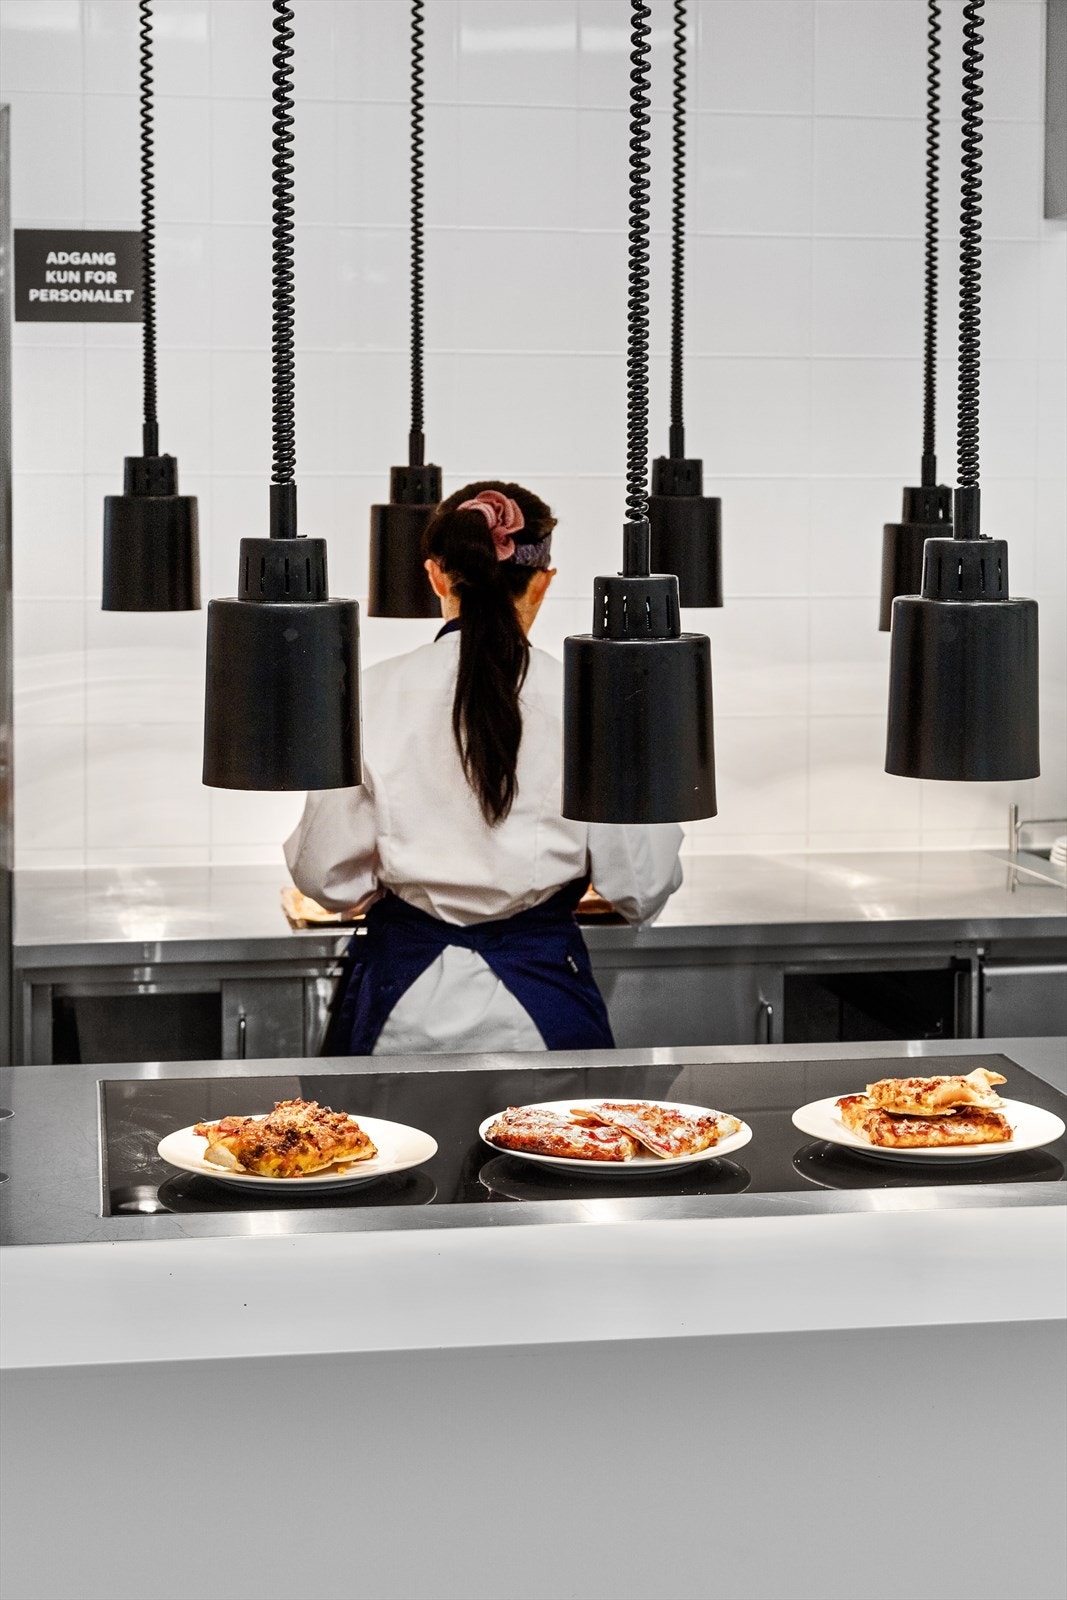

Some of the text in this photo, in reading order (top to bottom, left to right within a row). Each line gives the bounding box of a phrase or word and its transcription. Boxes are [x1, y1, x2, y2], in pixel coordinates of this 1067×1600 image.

[45, 251, 117, 266] ADGANG
[45, 270, 118, 284] KUN FOR
[28, 288, 135, 303] PERSONALET
